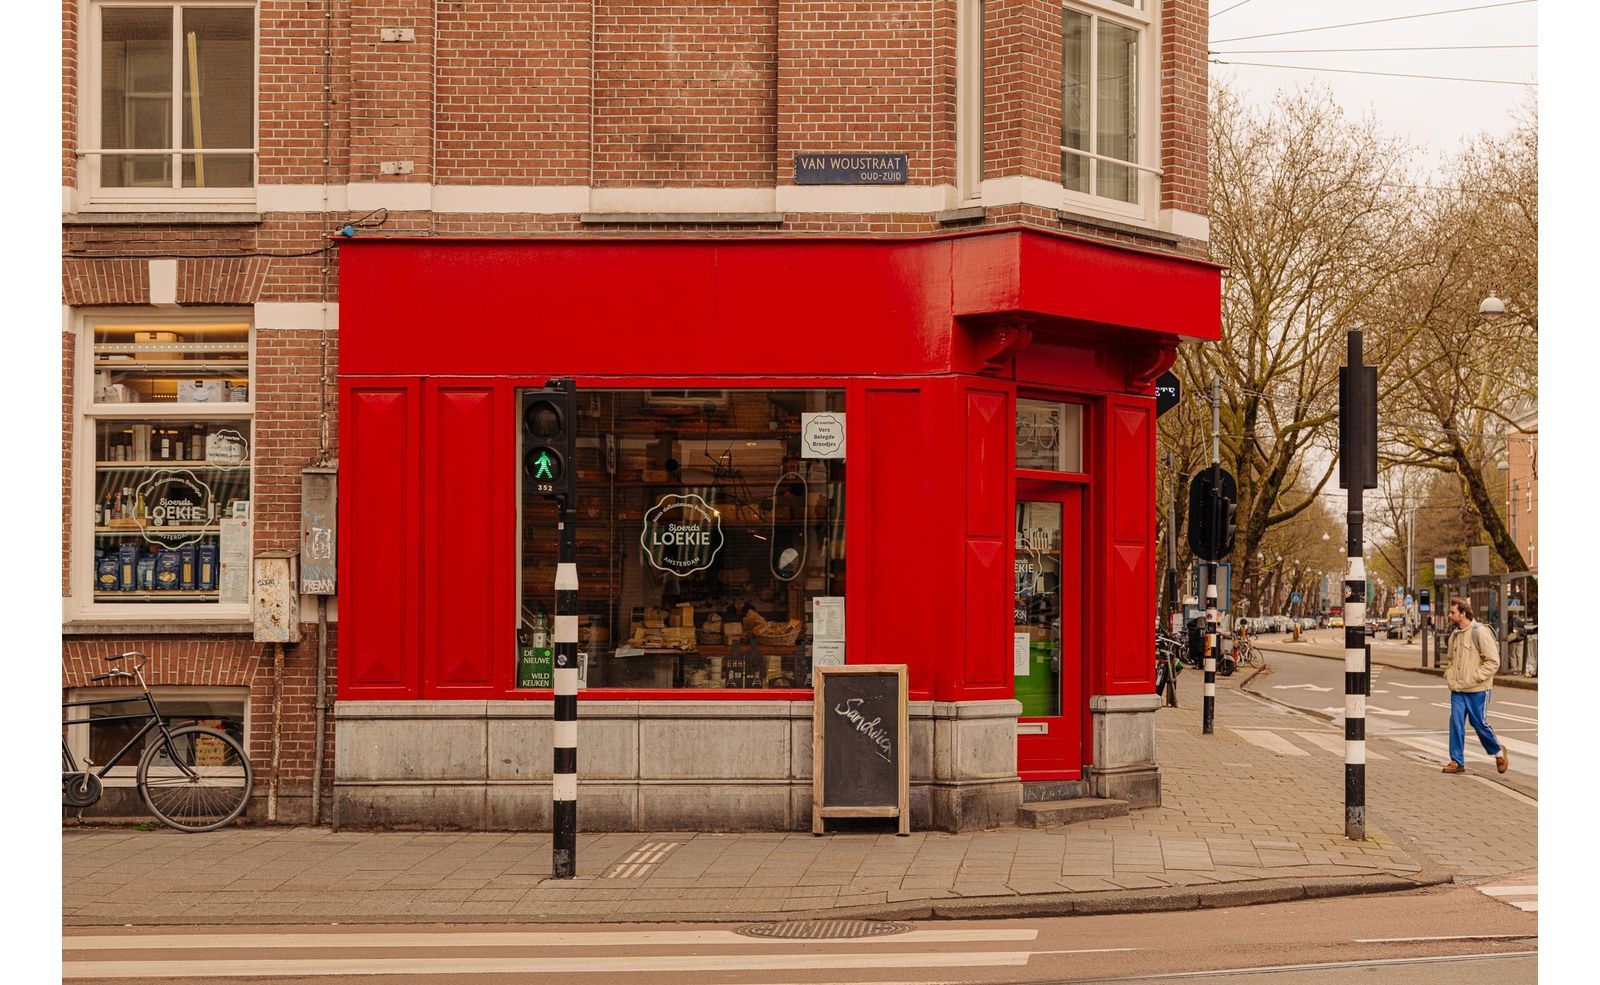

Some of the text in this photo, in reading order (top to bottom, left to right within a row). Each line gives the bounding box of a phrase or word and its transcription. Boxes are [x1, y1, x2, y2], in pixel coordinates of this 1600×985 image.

[801, 158, 901, 169] VAN WOUSTRAAT
[861, 172, 901, 180] OUD-ZUID
[160, 498, 191, 508] Sjoerds
[145, 506, 201, 519] LOEKIE
[668, 523, 701, 533] Sjoerds
[653, 532, 711, 546] LOEKIE
[664, 556, 701, 567] AMSTERDAM
[523, 649, 534, 657] DE
